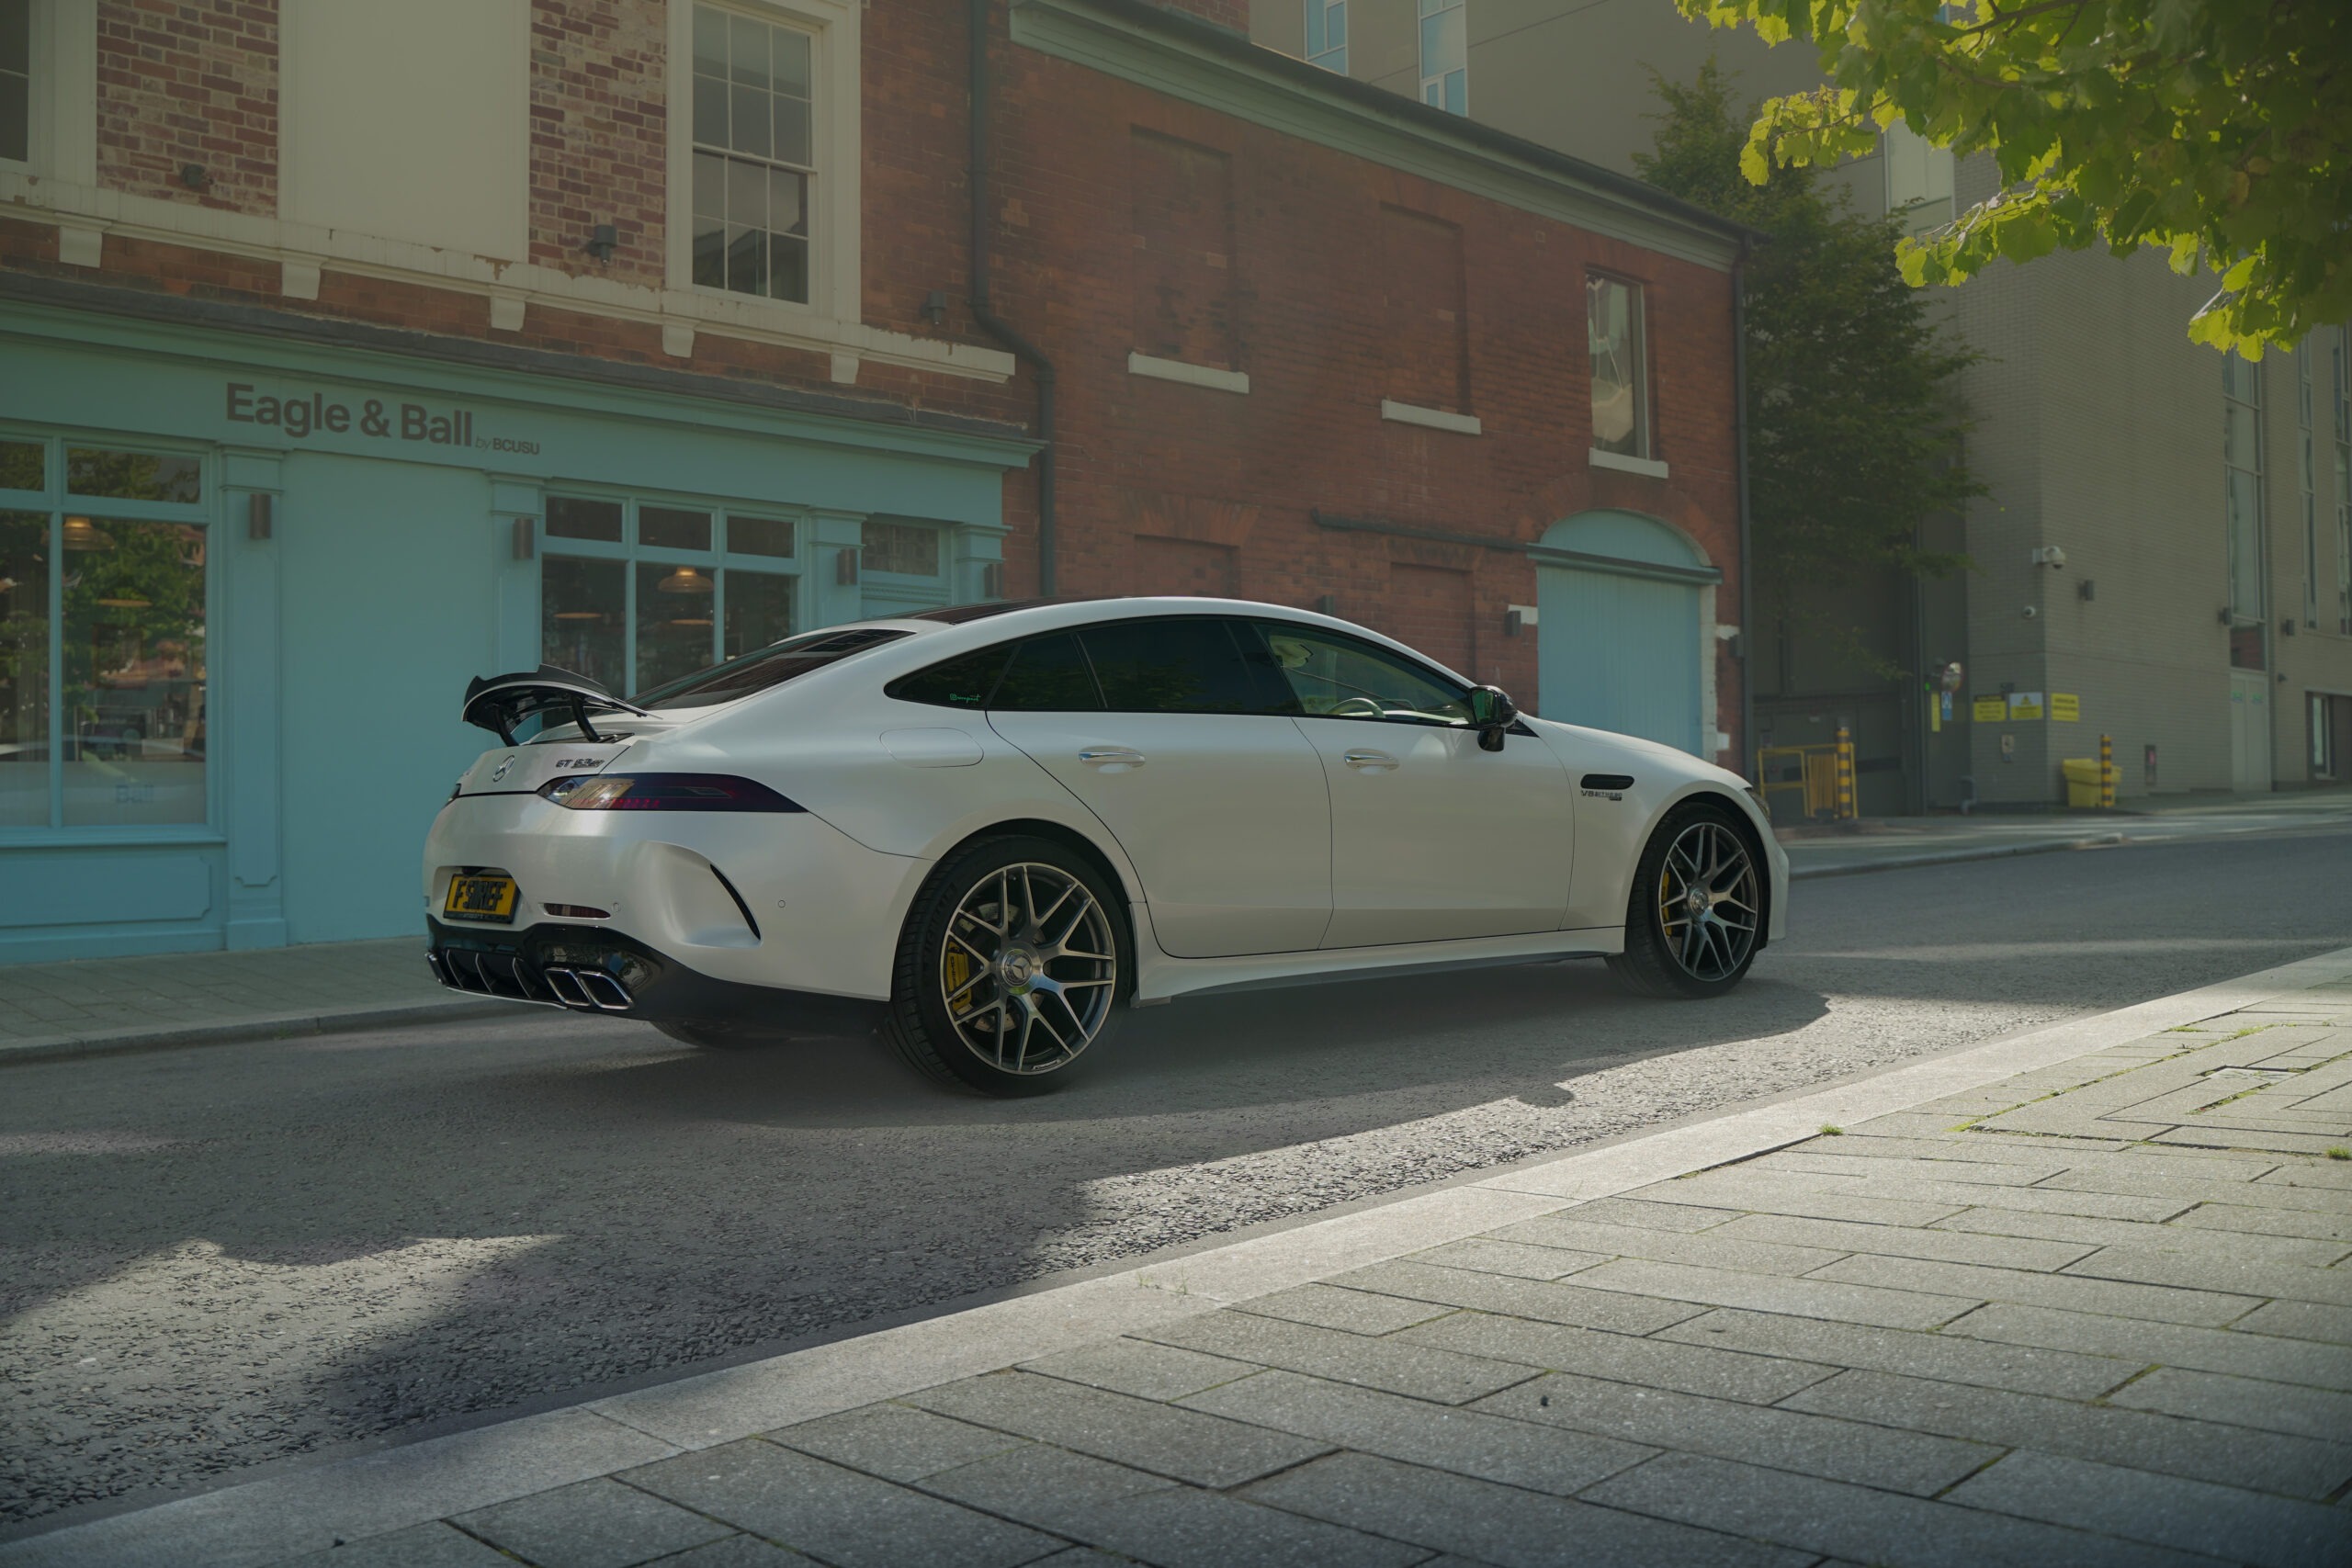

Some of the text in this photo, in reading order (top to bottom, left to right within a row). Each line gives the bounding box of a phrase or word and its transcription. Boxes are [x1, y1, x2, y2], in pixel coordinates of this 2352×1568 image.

[227, 382, 540, 456] Eagle & Ball by BCUSU
[116, 784, 154, 804] Ball
